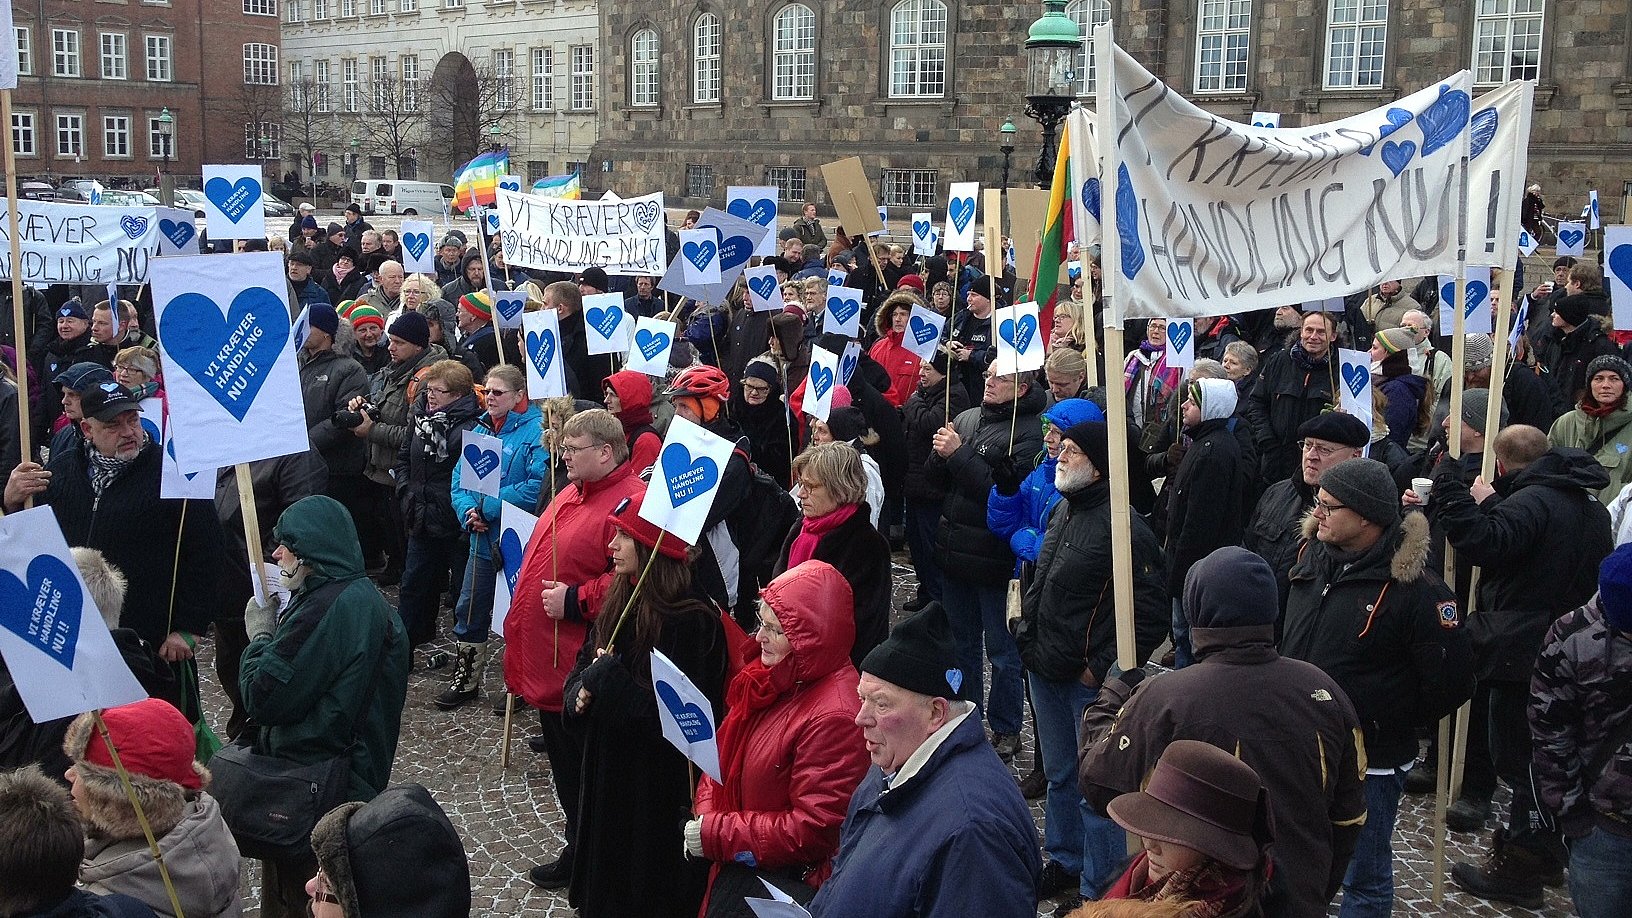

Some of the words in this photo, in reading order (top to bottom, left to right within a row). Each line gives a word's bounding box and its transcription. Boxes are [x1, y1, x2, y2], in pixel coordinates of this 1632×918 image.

[226, 190, 250, 212] HANDLING
[227, 185, 247, 205] KRÆVER
[230, 208, 240, 217] NU
[506, 195, 530, 231] VI
[550, 202, 634, 237] KRÆVER
[519, 232, 611, 267] HANDLING
[1141, 182, 1351, 300] HANDLING
[204, 361, 220, 377] VI
[216, 312, 256, 362] KRÆVER
[216, 326, 264, 389] HANDLING
[227, 376, 248, 401] NU
[244, 362, 258, 376] !!
[670, 476, 678, 484] VI
[679, 466, 704, 480] KRÆVER
[672, 474, 704, 491] HANDLING
[674, 490, 686, 500] NU
[31, 578, 52, 622] KRÆVER
[40, 589, 62, 645] HANDLING
[58, 620, 70, 634] !!
[28, 623, 39, 636] VI
[52, 632, 66, 654] NU
